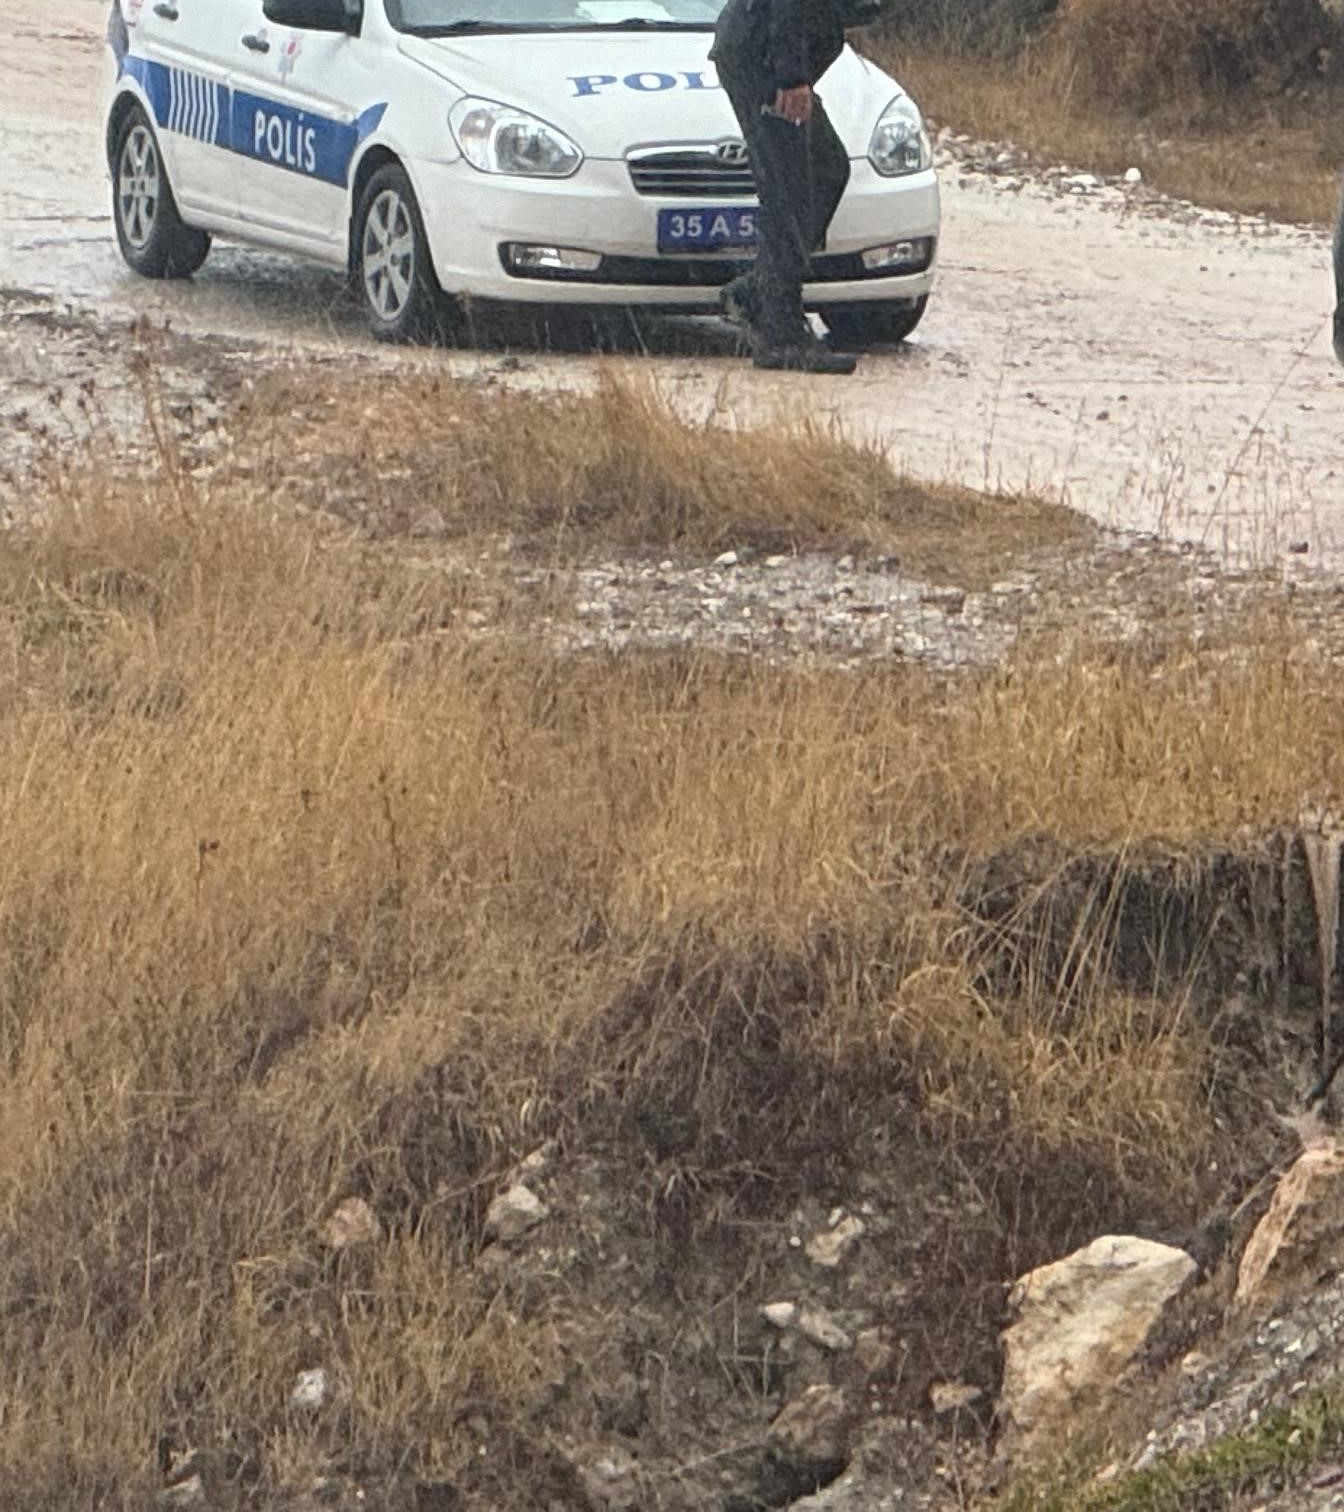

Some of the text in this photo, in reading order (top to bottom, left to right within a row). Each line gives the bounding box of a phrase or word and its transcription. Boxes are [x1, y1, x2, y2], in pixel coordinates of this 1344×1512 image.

[254, 110, 316, 172] POLİS
[670, 215, 703, 237] 35
[709, 214, 731, 237] A
